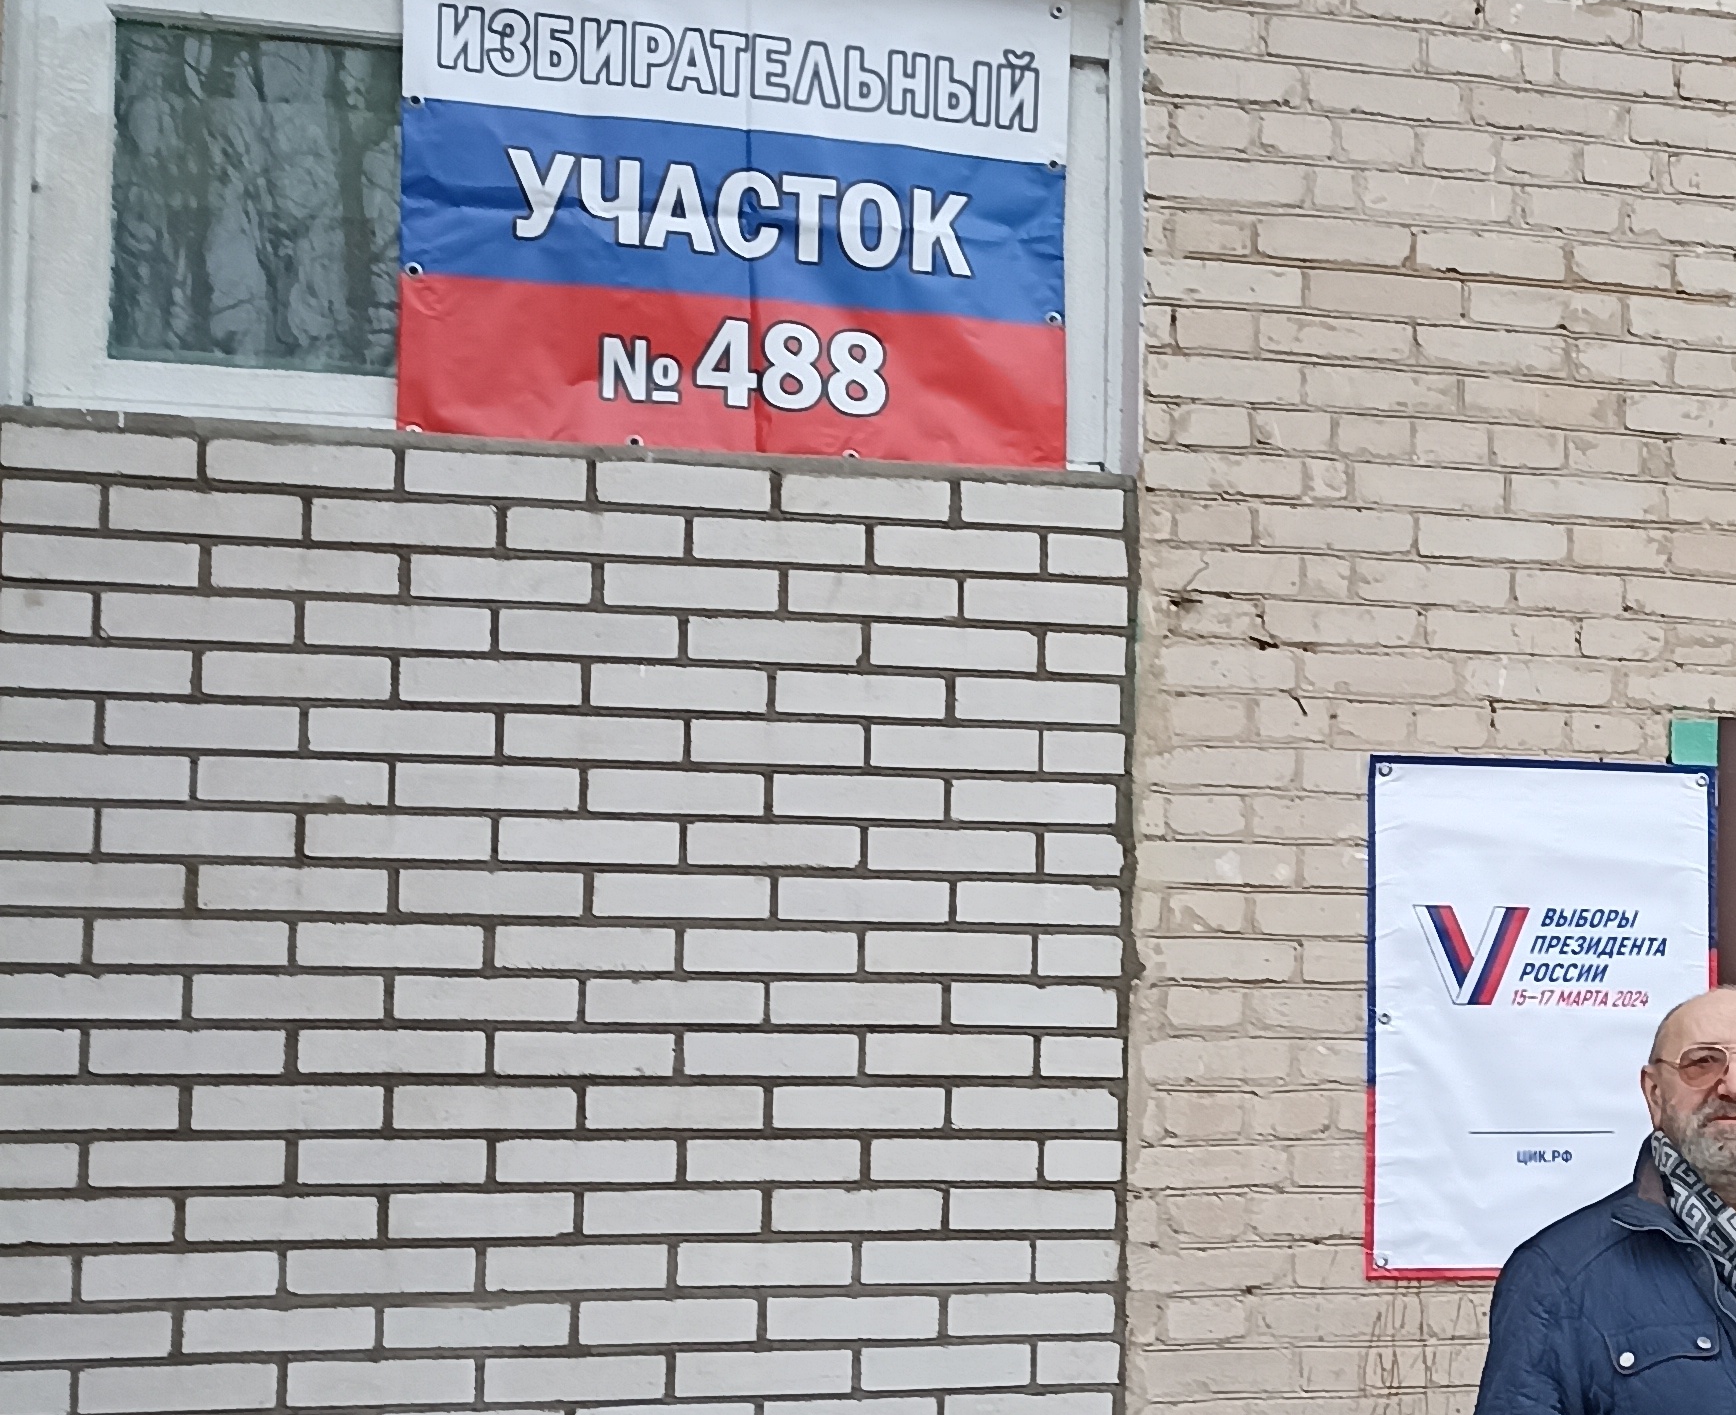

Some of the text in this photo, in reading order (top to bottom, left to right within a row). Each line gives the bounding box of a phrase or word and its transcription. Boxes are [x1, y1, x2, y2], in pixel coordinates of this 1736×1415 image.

[436, 2, 1040, 133] ИЗБИРАТЕЛЬНЫЙ
[507, 147, 974, 277] УЧАСТОК
[695, 319, 887, 417] 488
[1540, 907, 1640, 929] ВЫБОРЫ
[1529, 935, 1668, 959] ПРЕЗИДЕНТА
[1518, 962, 1610, 983] РОССИИ
[1556, 989, 1610, 1007] МАРТА
[1612, 990, 1650, 1008] 2024
[1516, 1149, 1573, 1166] ЦИК.РФ
